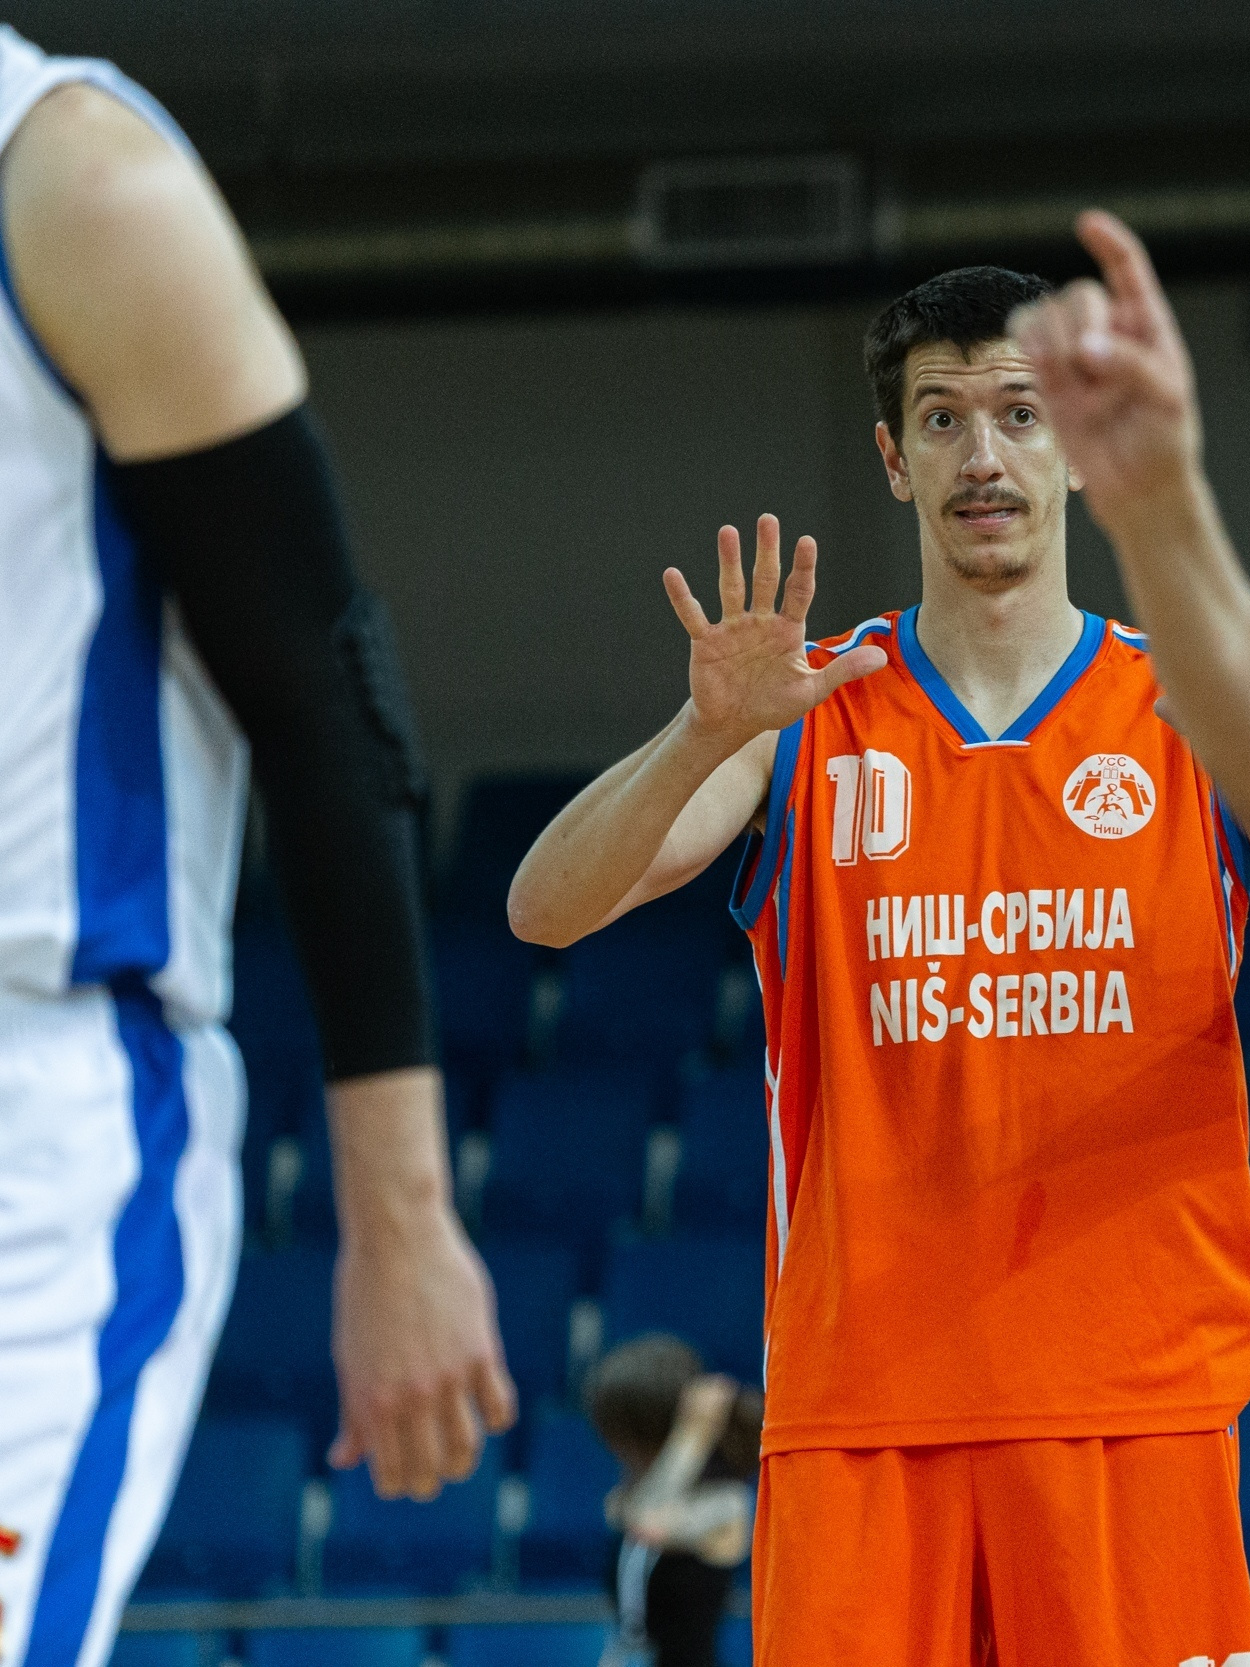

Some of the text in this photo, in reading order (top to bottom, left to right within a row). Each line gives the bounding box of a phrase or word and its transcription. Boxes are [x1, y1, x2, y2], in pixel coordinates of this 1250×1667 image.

[826, 748, 912, 867] 10
[1093, 823, 1123, 835] Ниш
[866, 888, 1135, 961] НИШ-СРБИЈА
[870, 961, 1134, 1046] NIŠ-SERBIA
